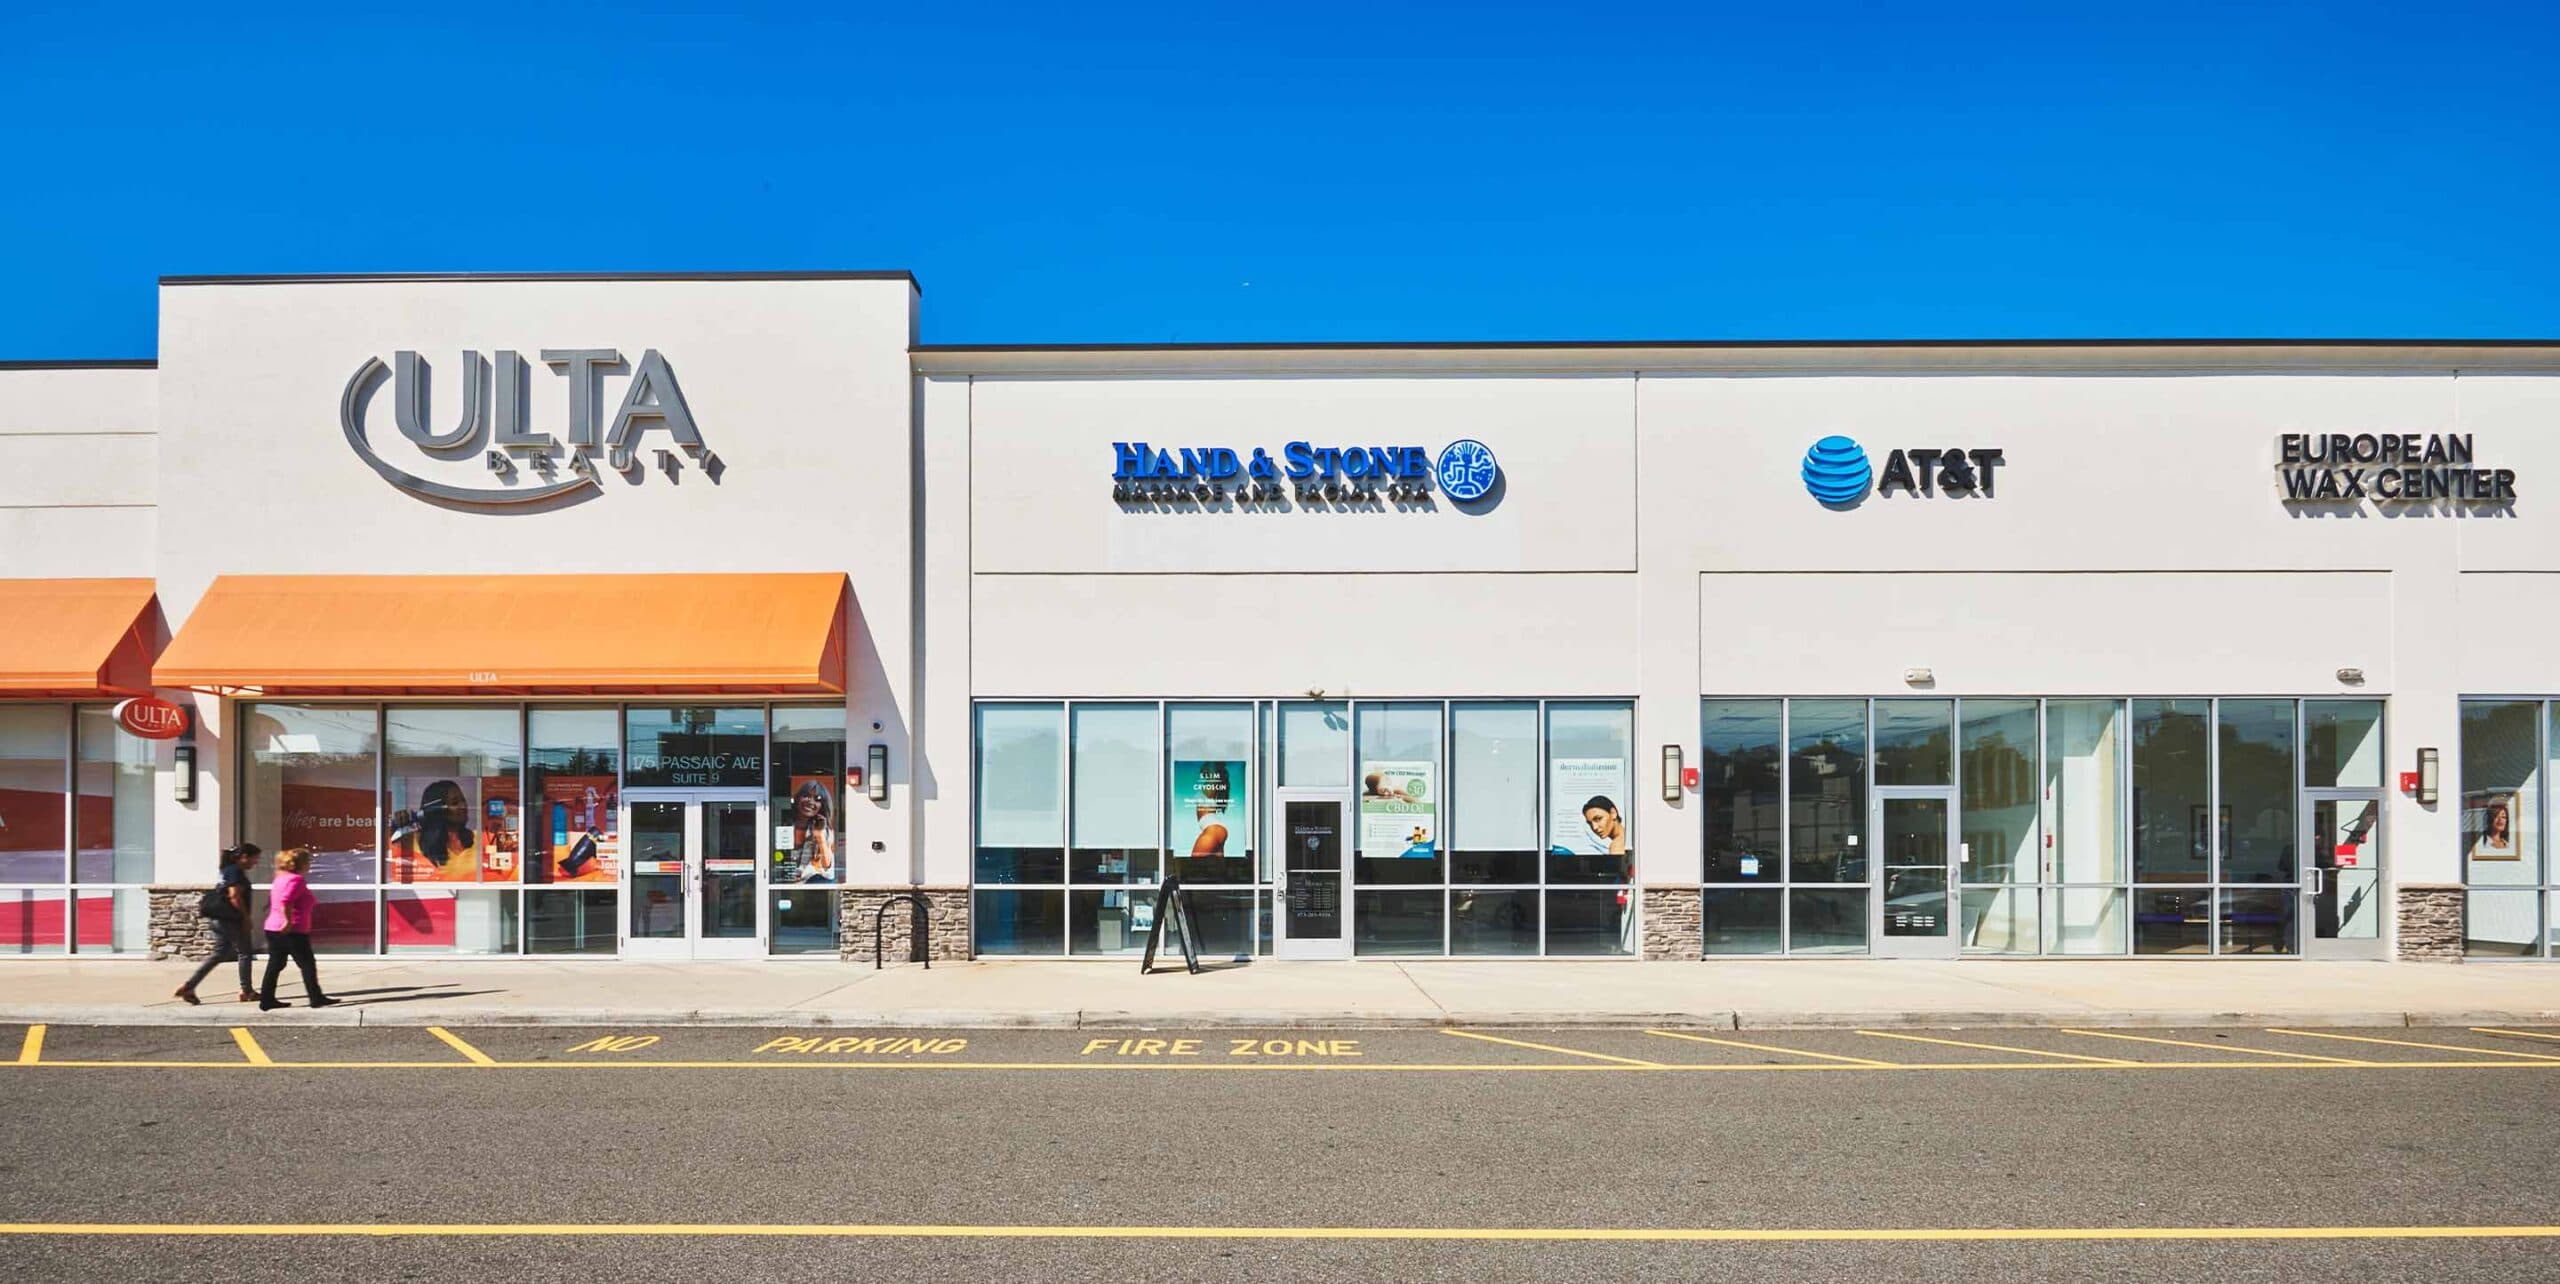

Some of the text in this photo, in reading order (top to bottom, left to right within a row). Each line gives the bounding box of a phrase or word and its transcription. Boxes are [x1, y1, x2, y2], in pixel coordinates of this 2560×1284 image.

[395, 349, 700, 447] ULTA
[2281, 433, 2473, 463] EUROPEAN
[487, 450, 718, 472] BEAUTY
[1112, 441, 1427, 479] HAND & STONE
[1878, 448, 2004, 491] AT&T
[2283, 468, 2517, 499] WAX CENTER
[1113, 484, 1429, 502] MASSAGE AND FACIAL SPA
[469, 672, 497, 682] ULTA
[134, 703, 181, 727] ULTA
[633, 756, 761, 769] 175 PASSAIC AVE
[672, 773, 720, 784] SUITE 9
[1386, 803, 1409, 813] CBD
[319, 818, 341, 827] are
[567, 1036, 968, 1054] NO PARKING
[1081, 1039, 1364, 1056] FIRE ZONE
